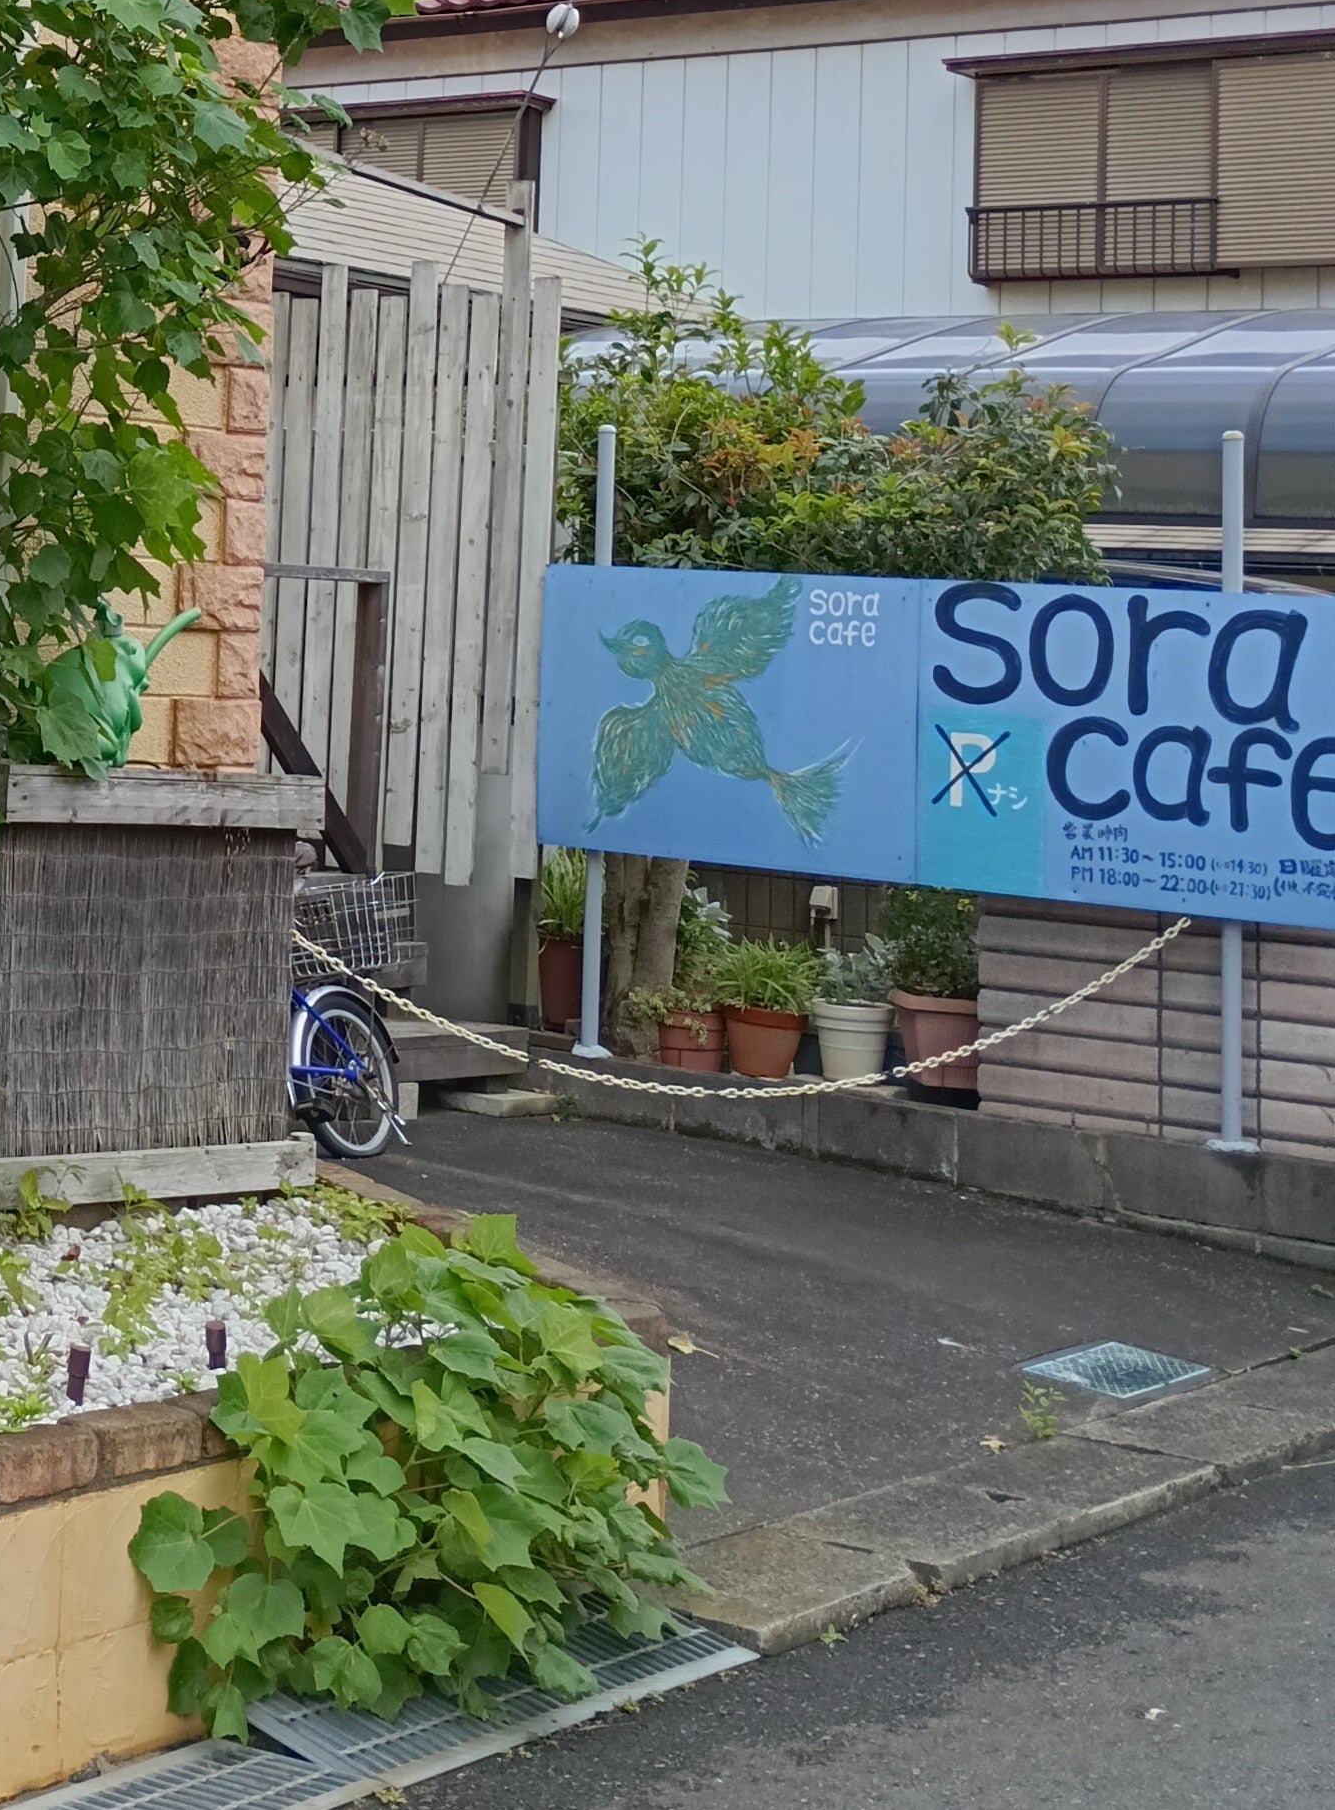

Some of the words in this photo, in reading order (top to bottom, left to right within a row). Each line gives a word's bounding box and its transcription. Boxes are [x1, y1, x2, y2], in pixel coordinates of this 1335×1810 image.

[808, 620, 877, 648] cafe
[987, 782, 1029, 811] ナシ
[1070, 845, 1094, 862] AM
[1098, 846, 1140, 865] 11:30
[1159, 851, 1207, 872] 15:00
[1070, 865, 1094, 884] PM
[1099, 867, 1141, 889] 18:00
[1159, 873, 1207, 895] 22:00
